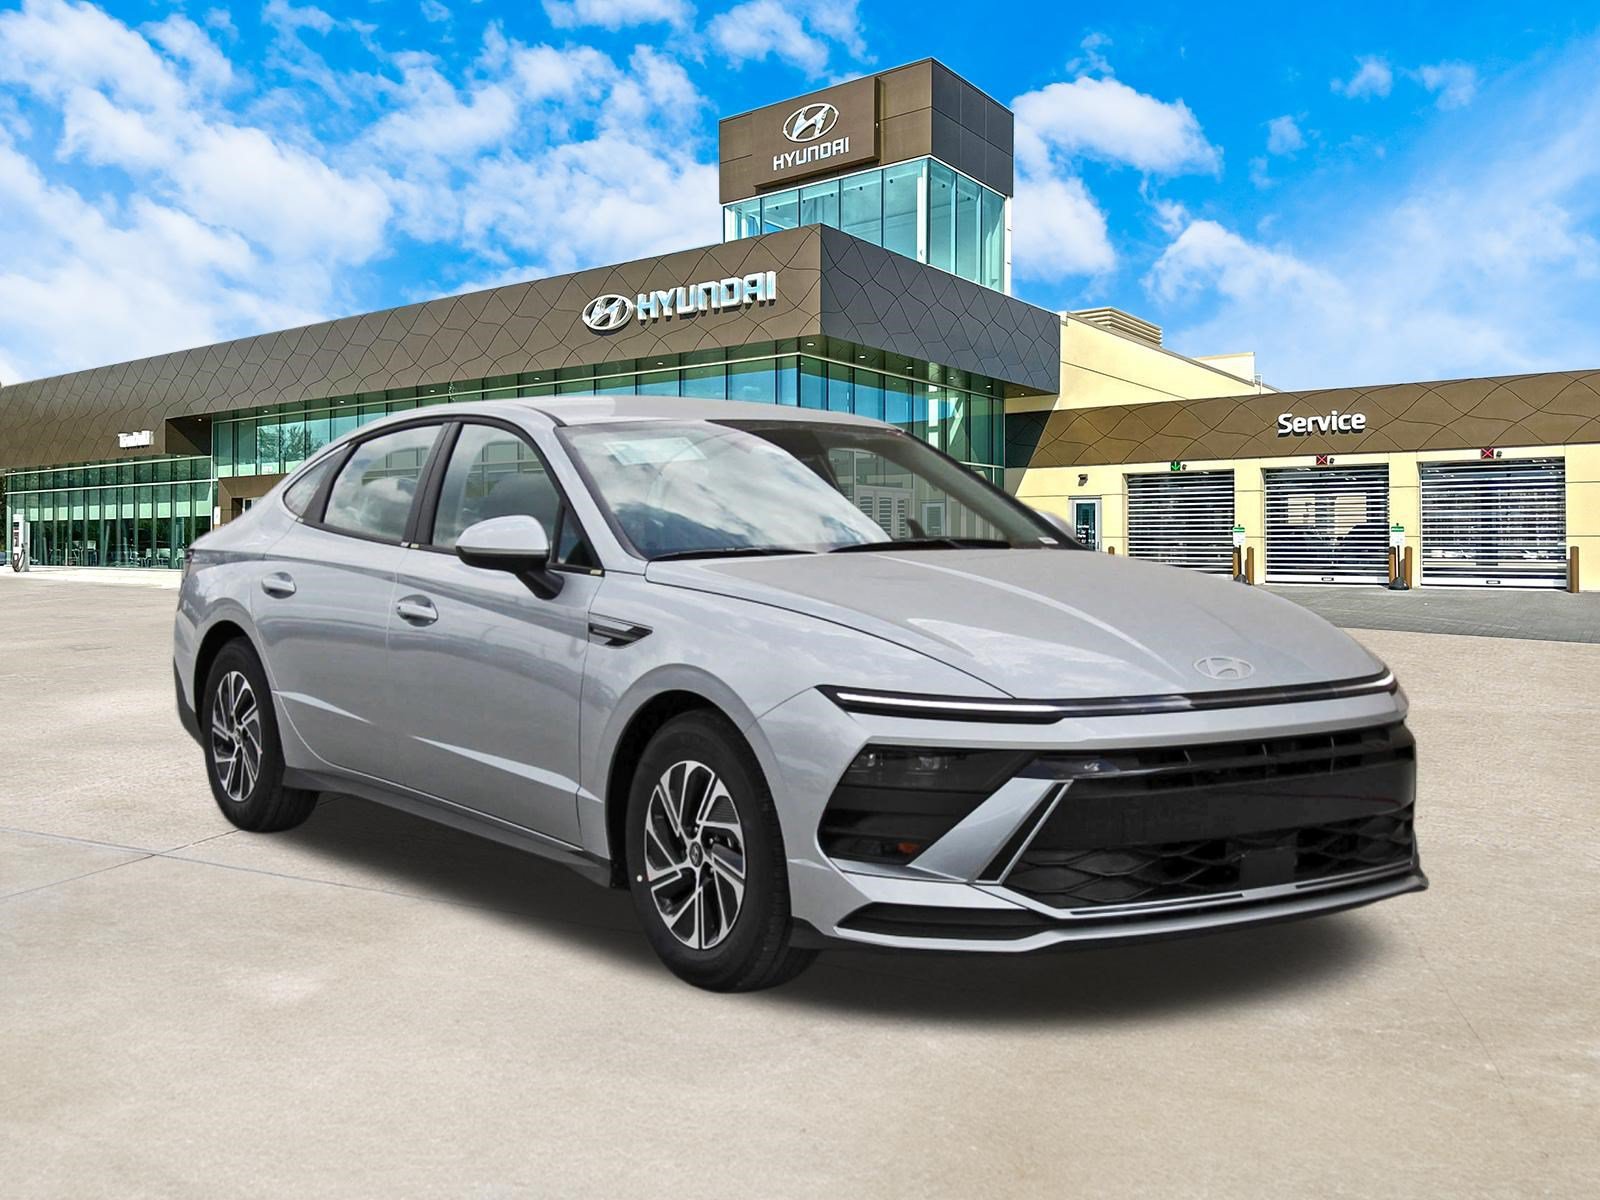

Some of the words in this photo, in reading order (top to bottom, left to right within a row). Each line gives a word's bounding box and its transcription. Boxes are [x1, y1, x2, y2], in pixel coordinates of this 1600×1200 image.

[773, 136, 850, 171] HYUNDAI
[636, 270, 777, 321] HYUNDAI
[1277, 410, 1367, 434] Service
